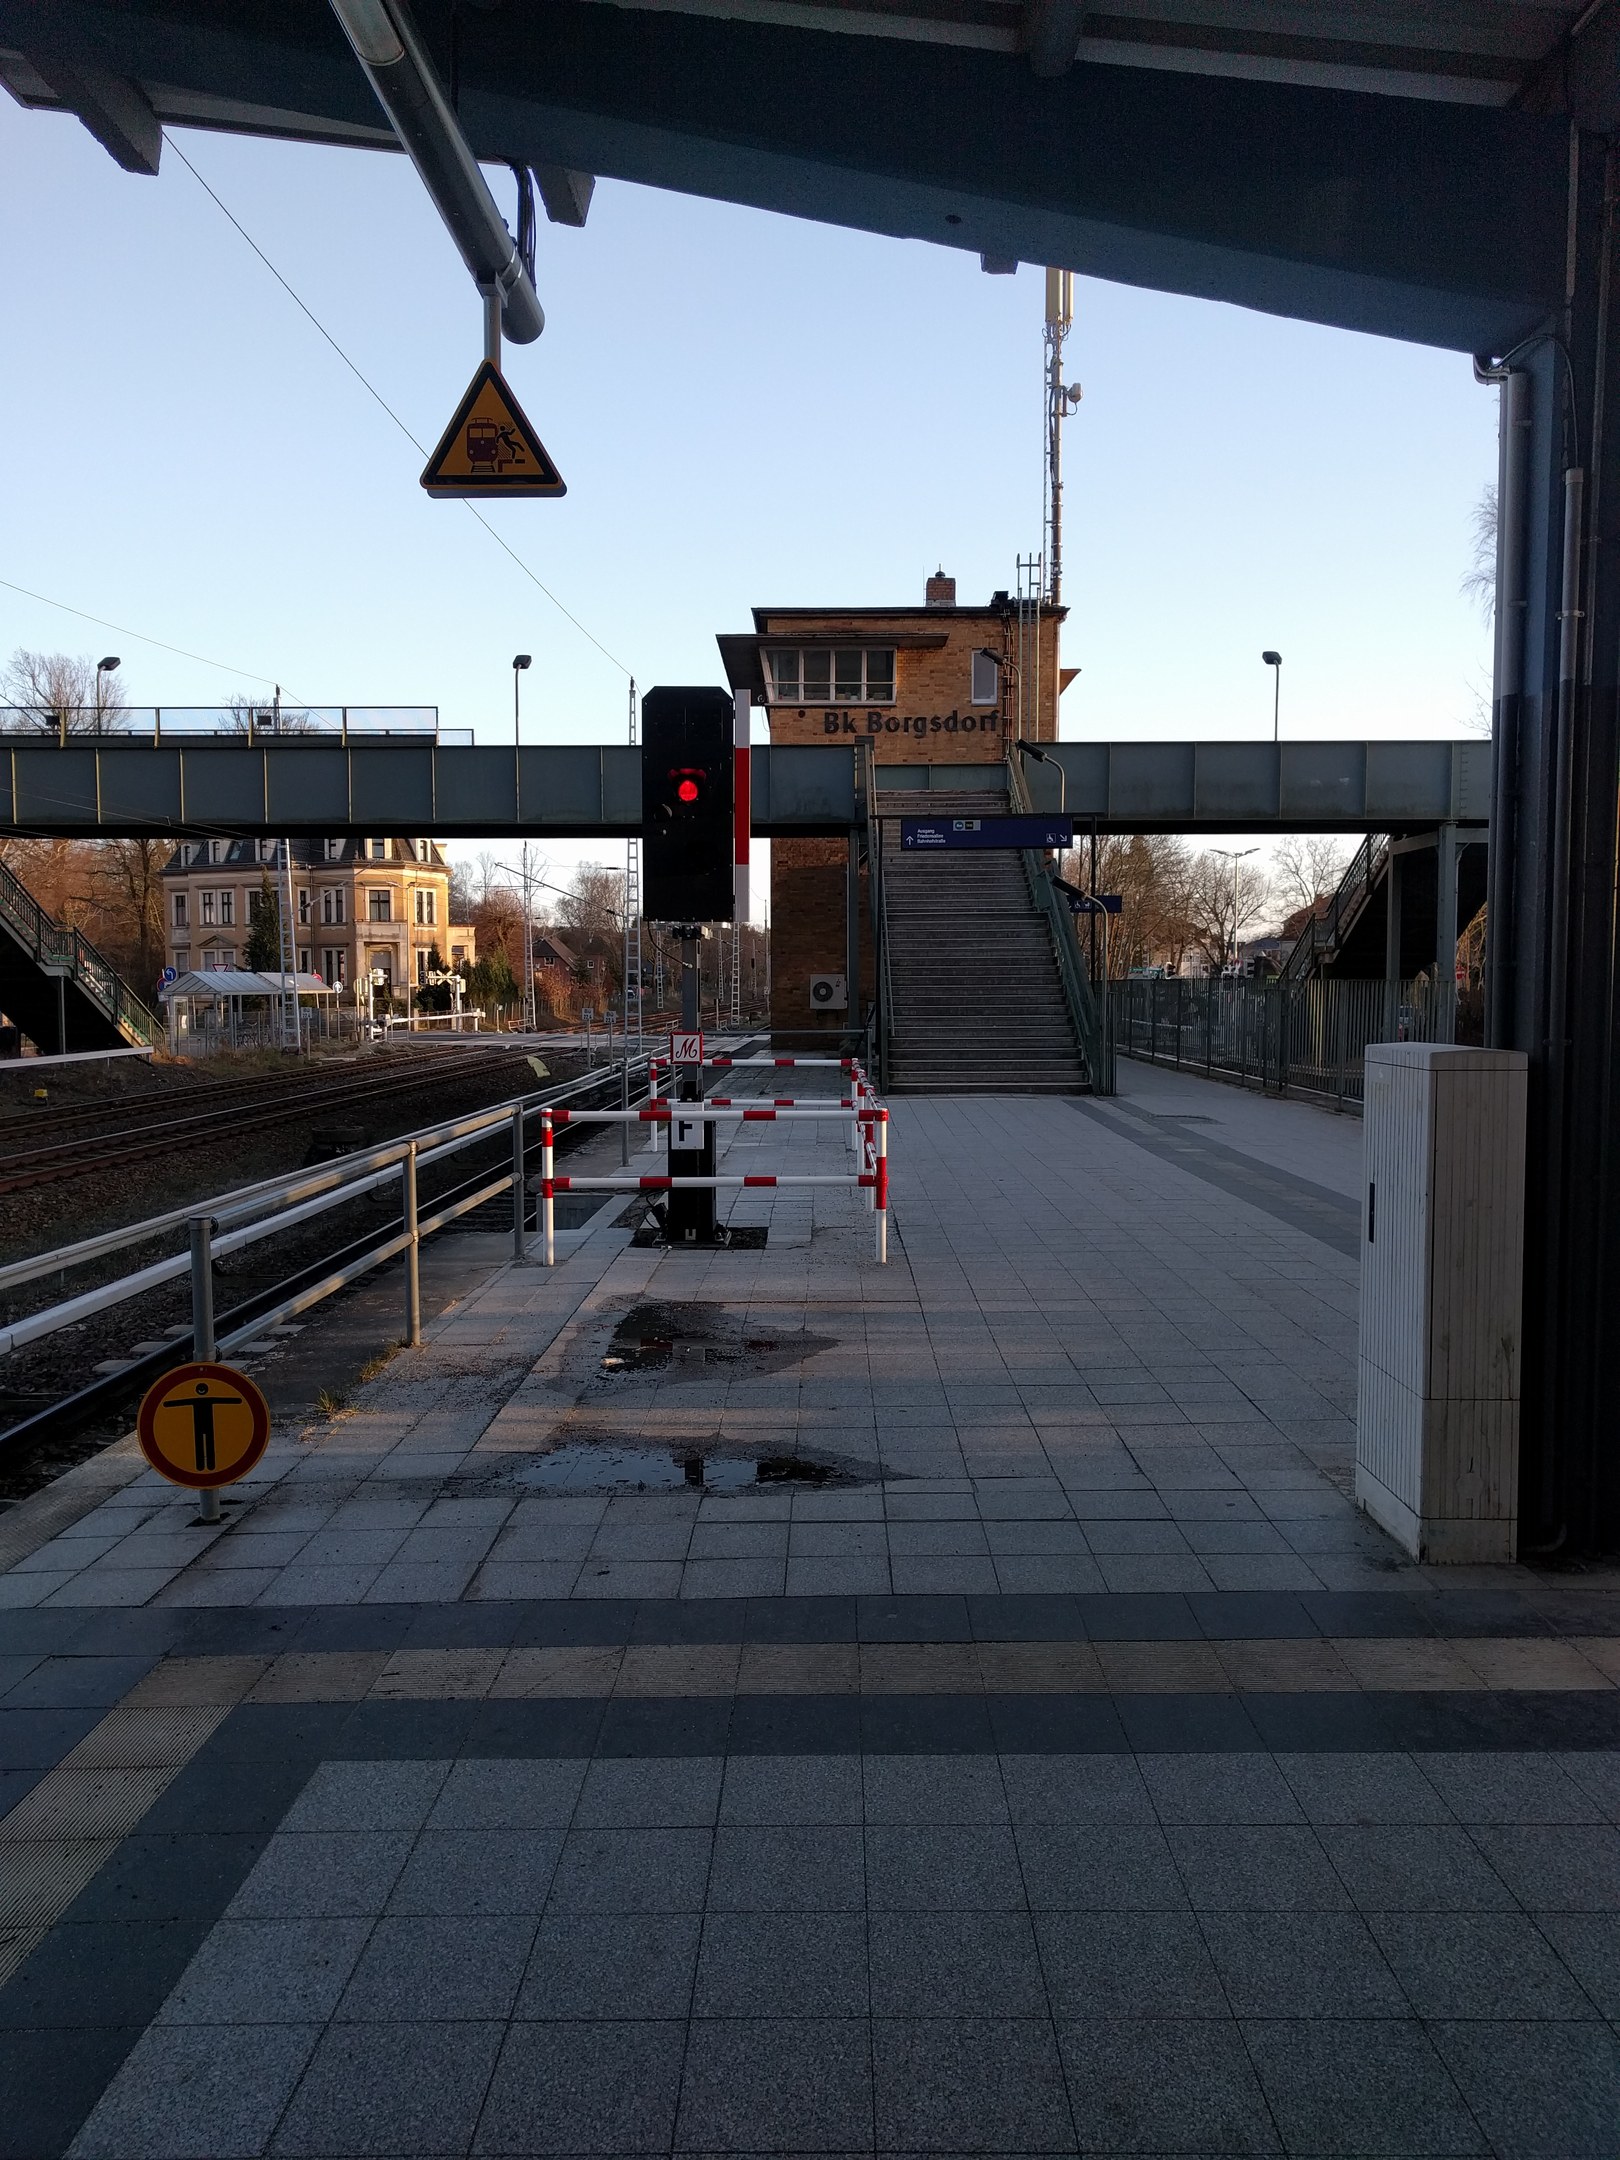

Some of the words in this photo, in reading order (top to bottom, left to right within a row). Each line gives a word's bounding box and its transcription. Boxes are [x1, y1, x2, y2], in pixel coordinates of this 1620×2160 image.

[824, 711, 857, 734] Bk
[867, 710, 1000, 738] Borgsdorf
[675, 1037, 698, 1059] M
[679, 1110, 696, 1142] F
